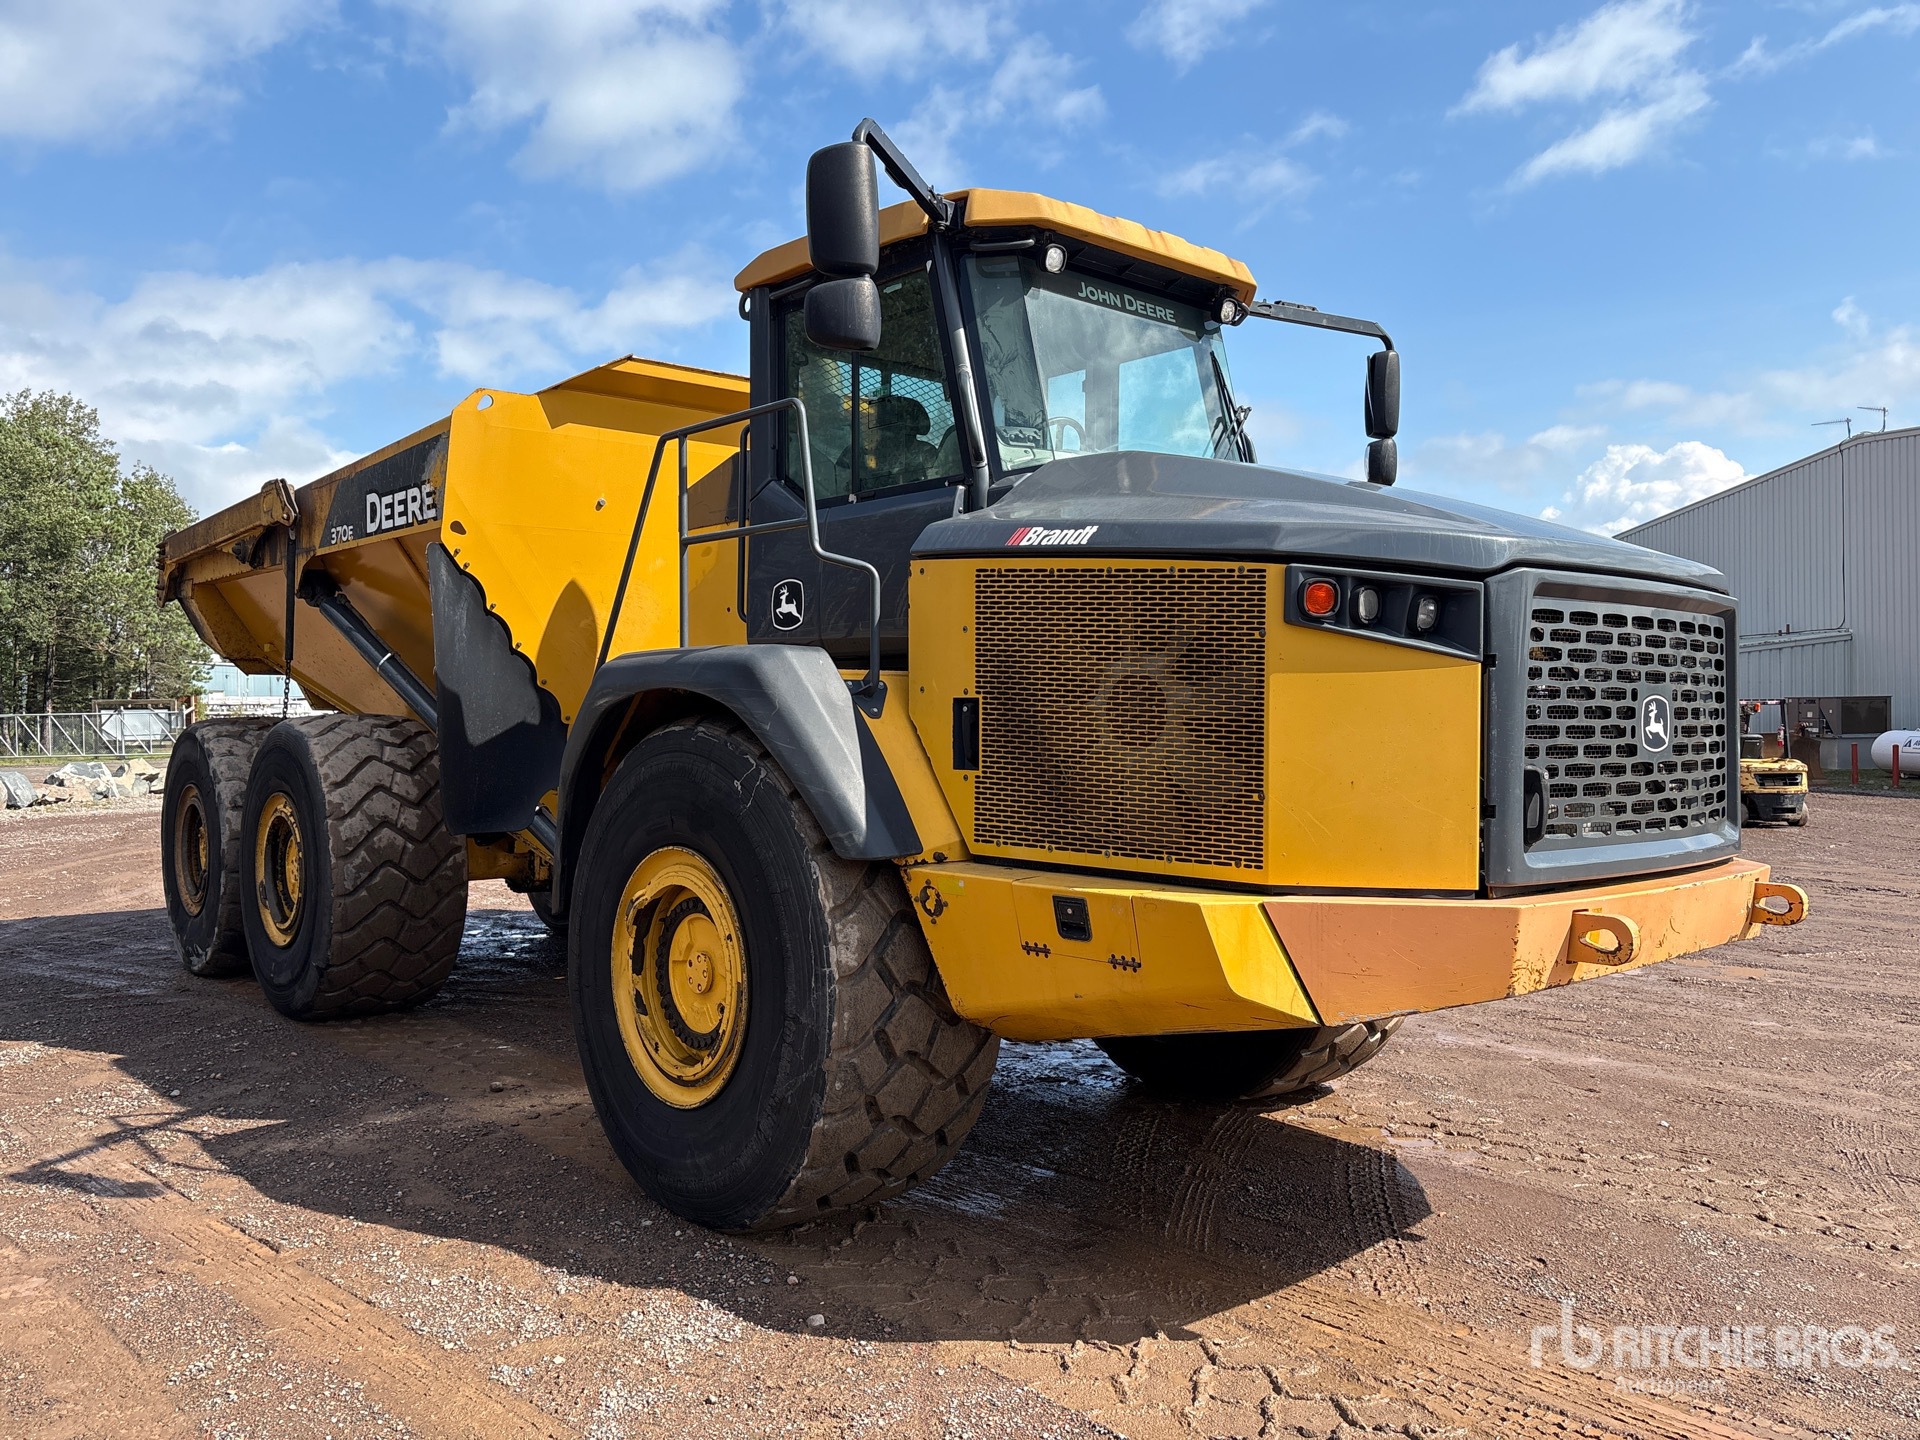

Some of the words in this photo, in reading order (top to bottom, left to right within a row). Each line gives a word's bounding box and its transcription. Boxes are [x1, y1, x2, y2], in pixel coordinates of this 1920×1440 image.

[1078, 281, 1121, 308] JOHN
[1123, 294, 1176, 323] DEERE
[365, 483, 437, 534] DEERE
[330, 524, 354, 545] 370E
[1018, 525, 1099, 546] Brandt
